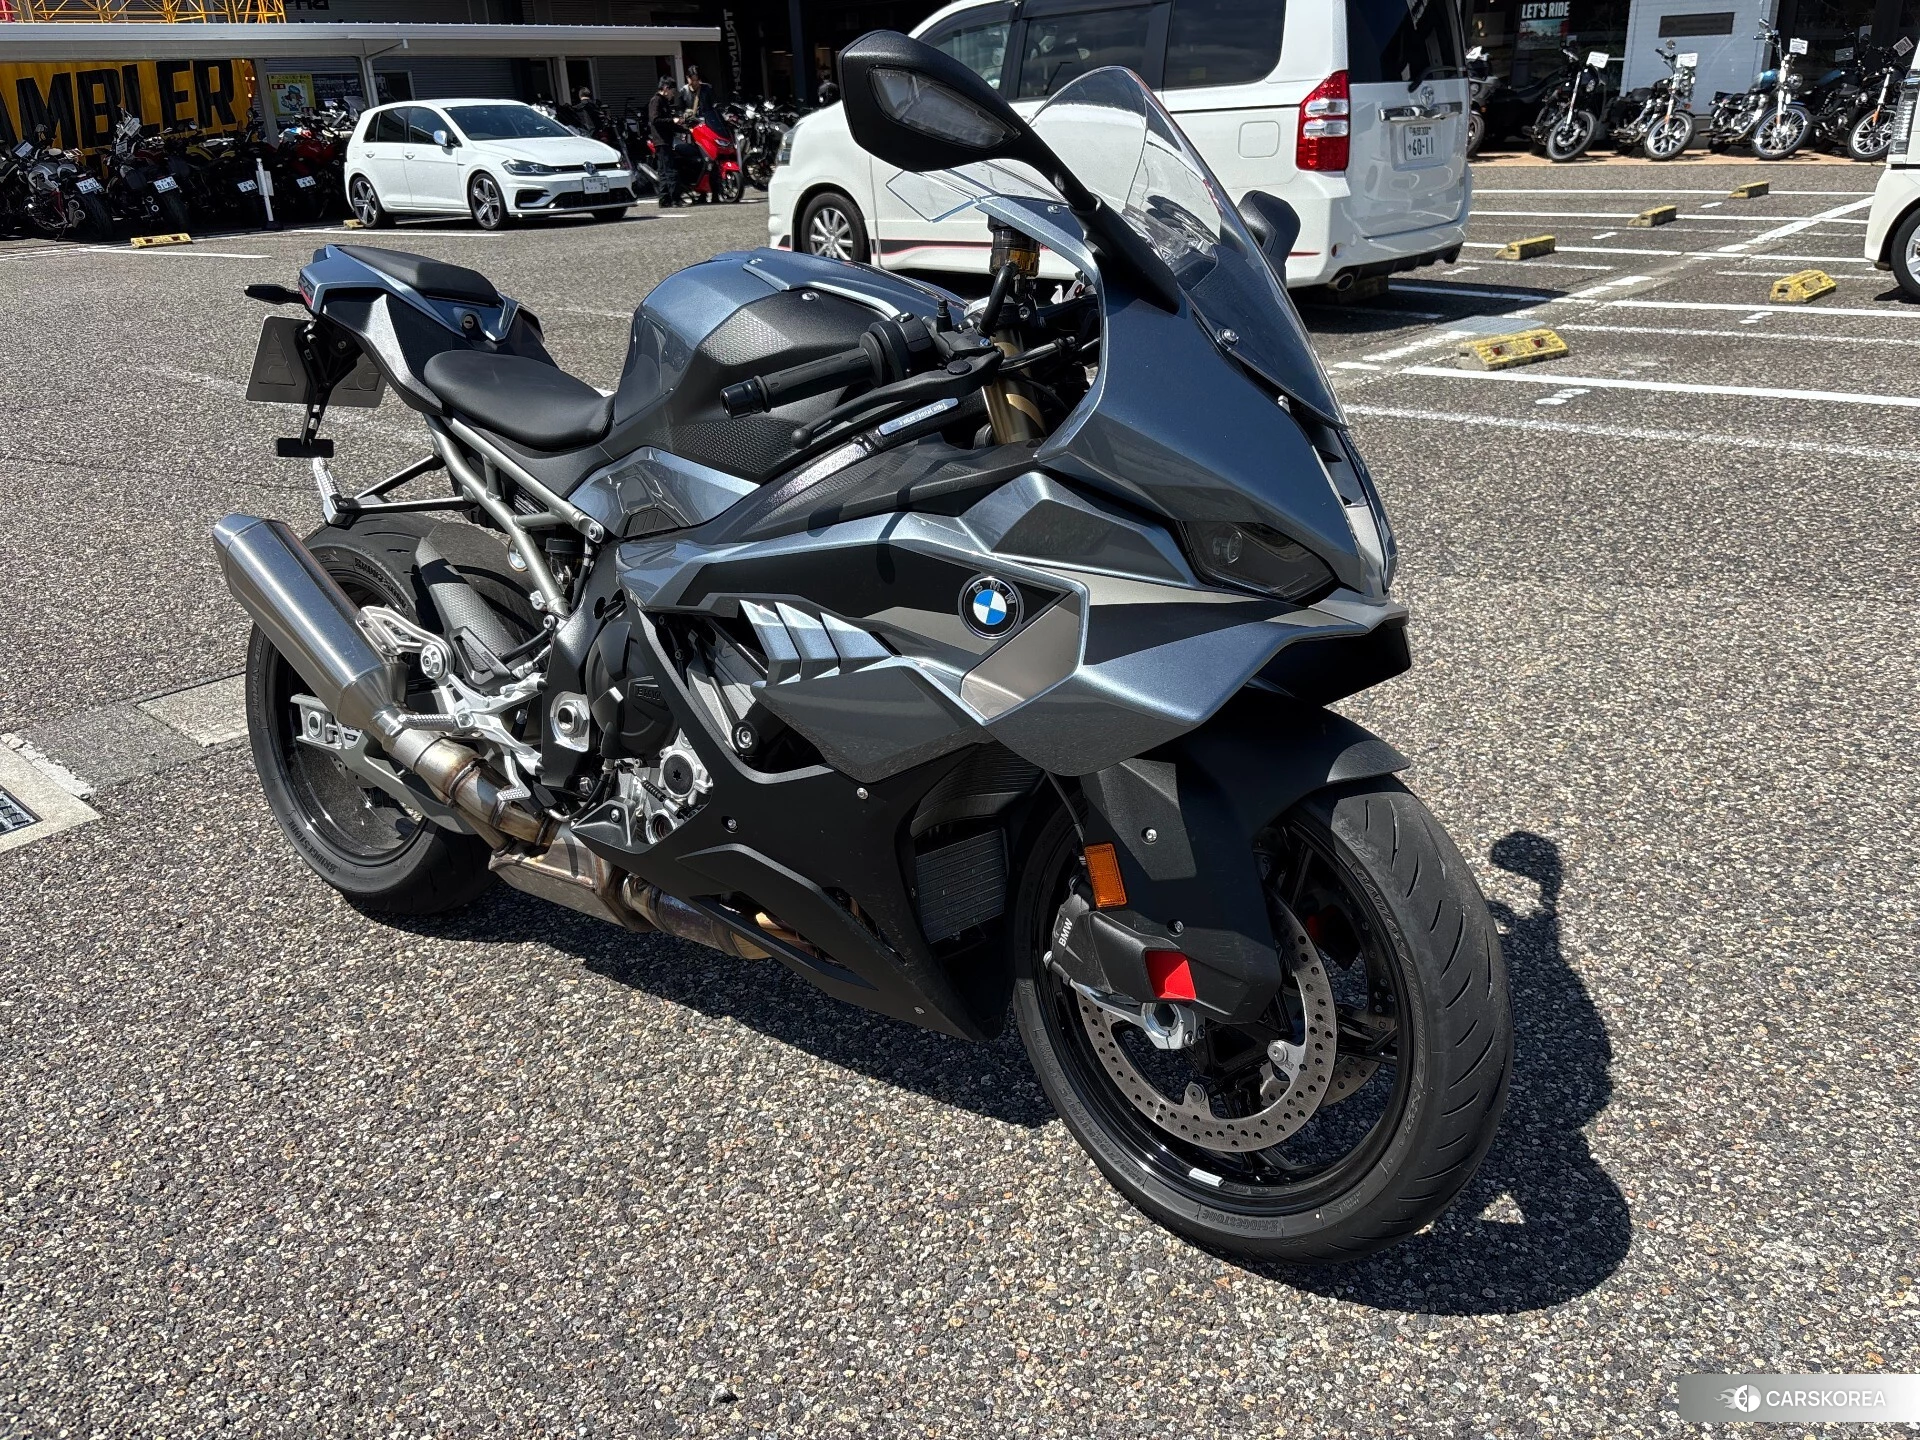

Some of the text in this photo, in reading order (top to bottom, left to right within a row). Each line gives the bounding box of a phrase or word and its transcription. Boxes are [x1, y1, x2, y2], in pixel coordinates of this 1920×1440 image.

[1521, 1, 1570, 19] LET'S RIDE
[972, 580, 1016, 605] BMW
[1058, 918, 1074, 947] BMW
[1201, 1208, 1279, 1233] BRIDGESTONE
